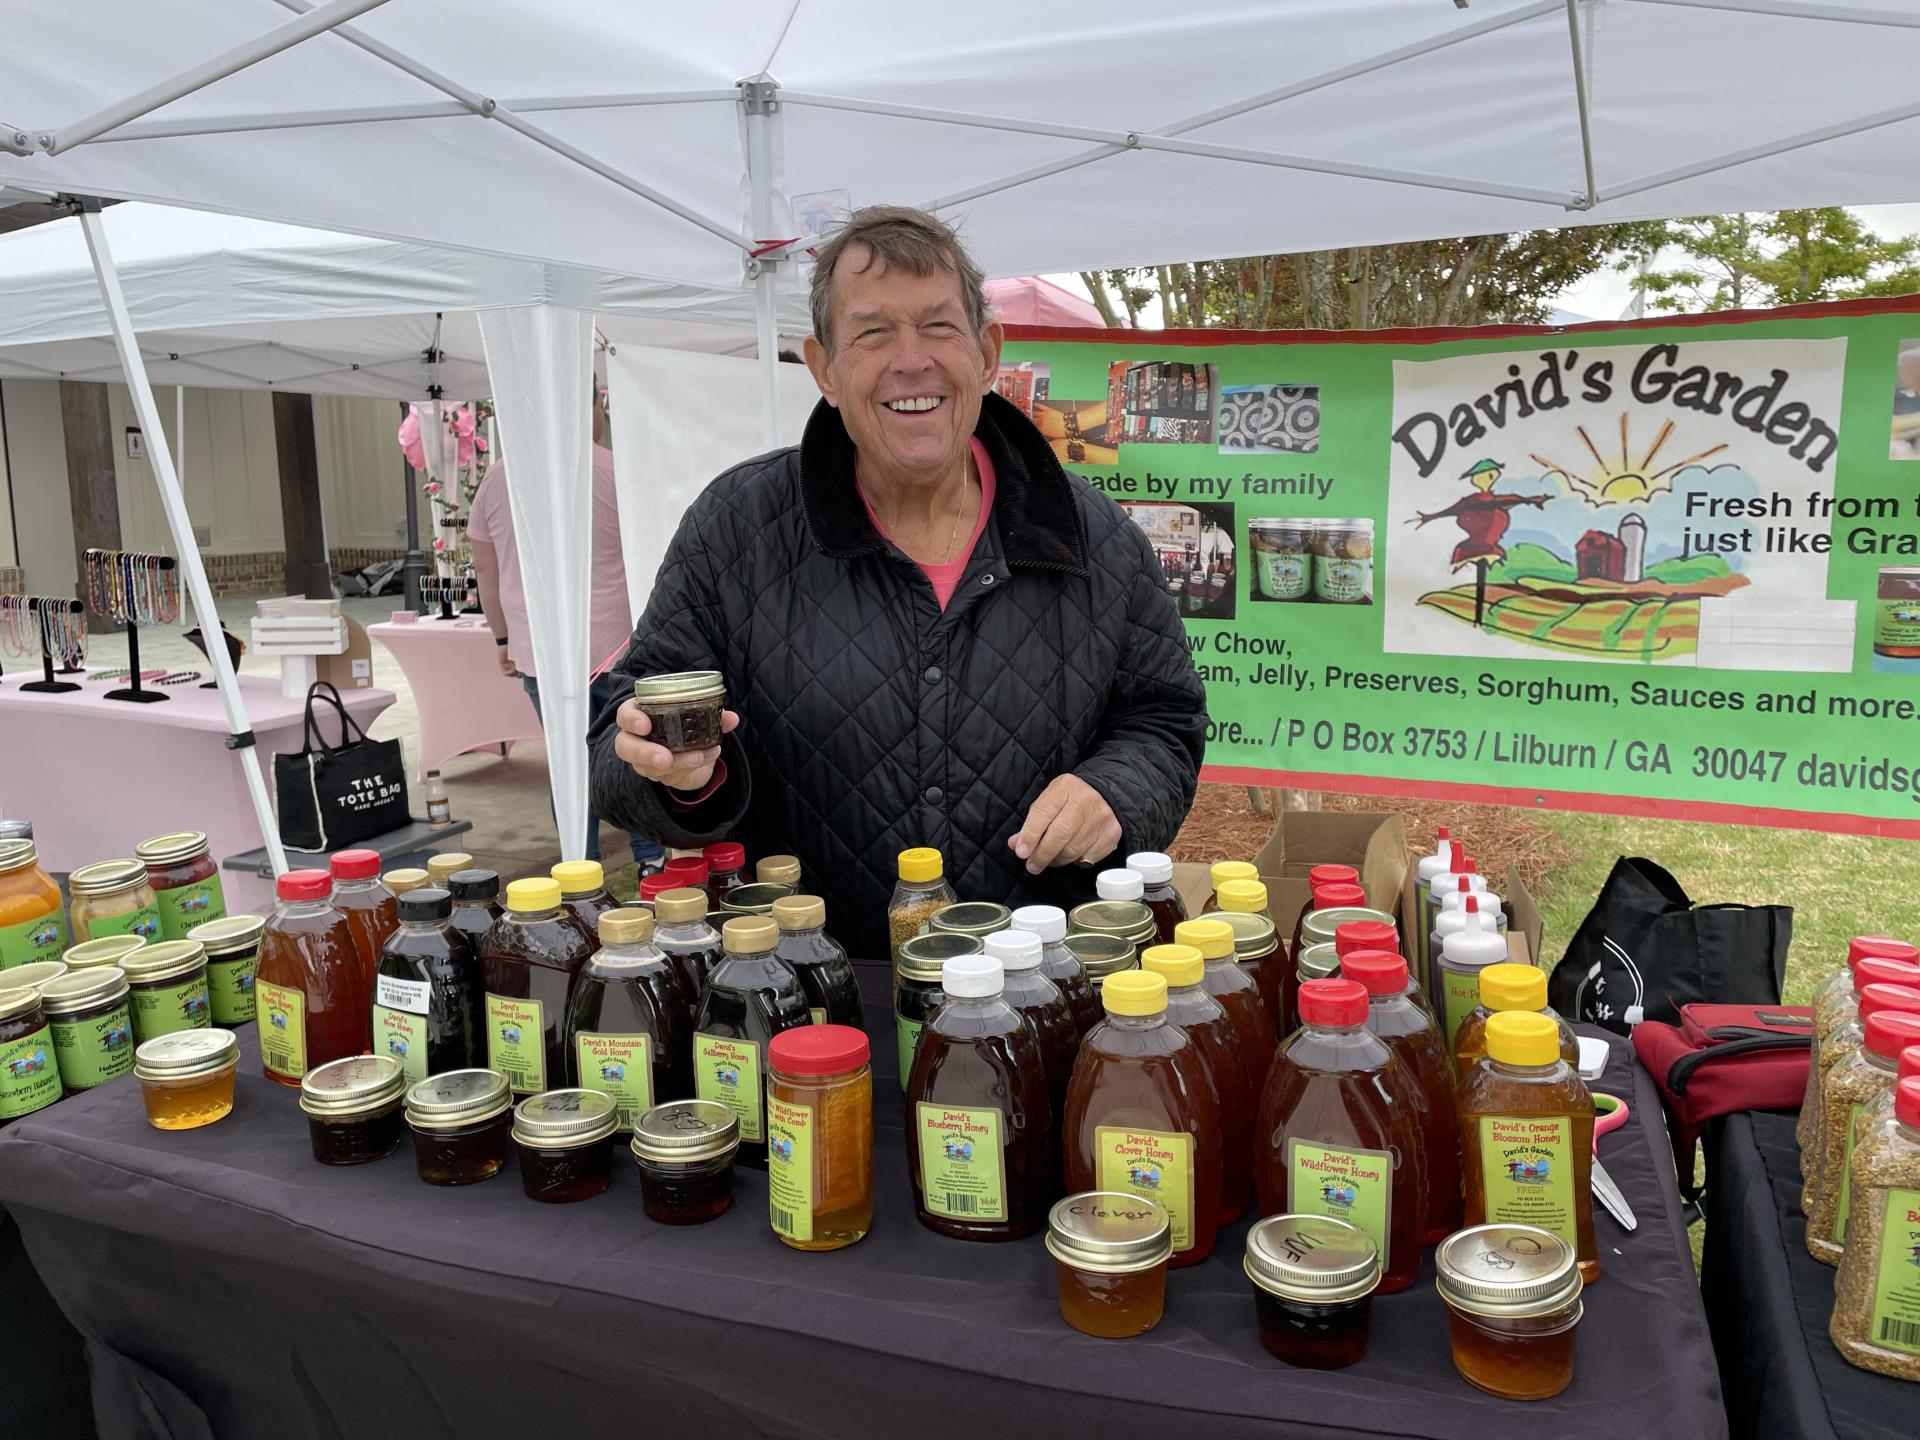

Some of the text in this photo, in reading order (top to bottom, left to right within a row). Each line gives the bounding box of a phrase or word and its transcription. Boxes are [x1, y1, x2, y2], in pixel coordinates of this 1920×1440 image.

[1392, 344, 1839, 478] David's Garden
[1146, 472, 1180, 499] by
[1189, 477, 1233, 500] my
[1242, 472, 1335, 500] family
[1685, 491, 1793, 518] Fresh
[1807, 490, 1899, 518] from
[1681, 528, 1753, 558] just
[1766, 526, 1833, 554] like
[1214, 631, 1293, 660] Chow,
[1191, 660, 1240, 687] am,
[1249, 662, 1315, 692] Jelly,
[1325, 665, 1468, 700] Preserves,
[1477, 672, 1620, 709] Sorghum,
[1630, 680, 1746, 711] Sauces
[1755, 690, 1817, 715] and
[1205, 719, 1264, 746] ore...
[1287, 718, 1306, 747] P
[1313, 719, 1334, 750] O
[1342, 722, 1396, 754] Box
[1403, 726, 1468, 760] 3753
[1493, 731, 1597, 769] Lilburn
[1625, 740, 1673, 775] GA
[1691, 745, 1788, 783] 30047
[350, 774, 384, 791] THE
[337, 782, 401, 807] TOTE BAG
[177, 983, 198, 1000] David's
[1451, 985, 1466, 999] Hot
[95, 1013, 119, 1032] David's
[514, 1011, 534, 1023] Honey
[582, 1037, 642, 1048] David's Mountain
[714, 1041, 736, 1052] David's
[592, 1047, 632, 1059] Gold Honey
[703, 1047, 750, 1064] Gallberry Honey
[774, 1104, 809, 1119] Wildflower
[942, 1111, 971, 1122] David's
[787, 1116, 807, 1127] Comb
[927, 1118, 989, 1136] Blueberry Honey
[1492, 1121, 1560, 1134] David's Orange
[1126, 1134, 1159, 1147] David's
[1492, 1132, 1561, 1145] Blossom Honey
[1115, 1144, 1174, 1162] Clover Honey
[1323, 1152, 1357, 1166] David's
[1502, 1145, 1555, 1158] David's Garden
[1126, 1157, 1165, 1170] David's Garden
[1300, 1158, 1380, 1182] Wildflower Honey
[1319, 1174, 1361, 1190] David's Garden
[1516, 1186, 1544, 1195] FRESH
[979, 1197, 999, 1207] WoW
